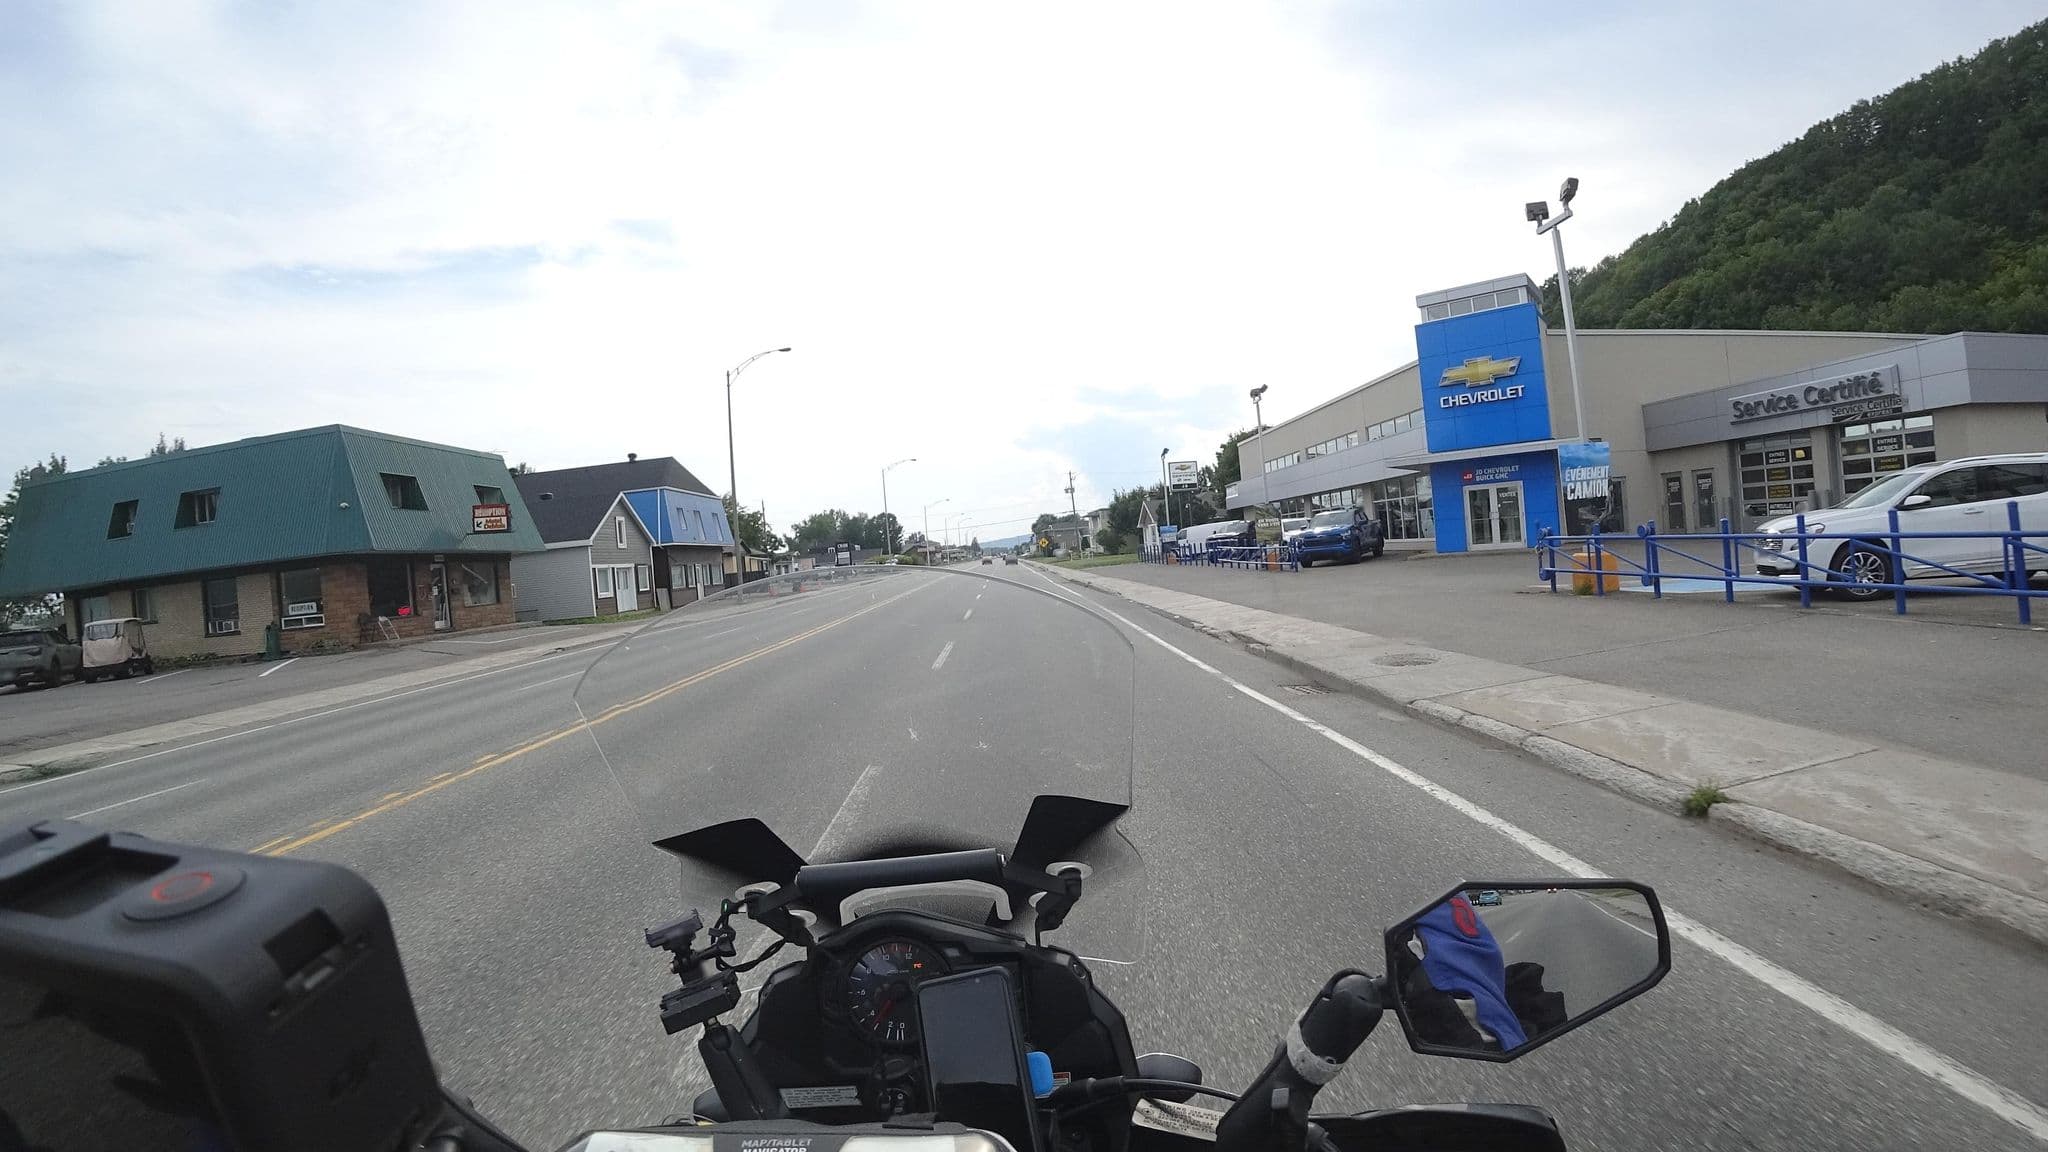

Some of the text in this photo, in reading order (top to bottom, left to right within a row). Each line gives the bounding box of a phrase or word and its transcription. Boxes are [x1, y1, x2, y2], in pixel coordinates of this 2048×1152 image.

[1440, 385, 1524, 408] CHEVROLET
[1733, 371, 1883, 419] Service Certifié
[1831, 404, 1864, 416] Service
[1484, 465, 1519, 475] CHEVROLET
[1495, 472, 1509, 480] GMC
[1567, 478, 1609, 500] CAMION
[741, 1138, 813, 1148] MAP/TABLET
